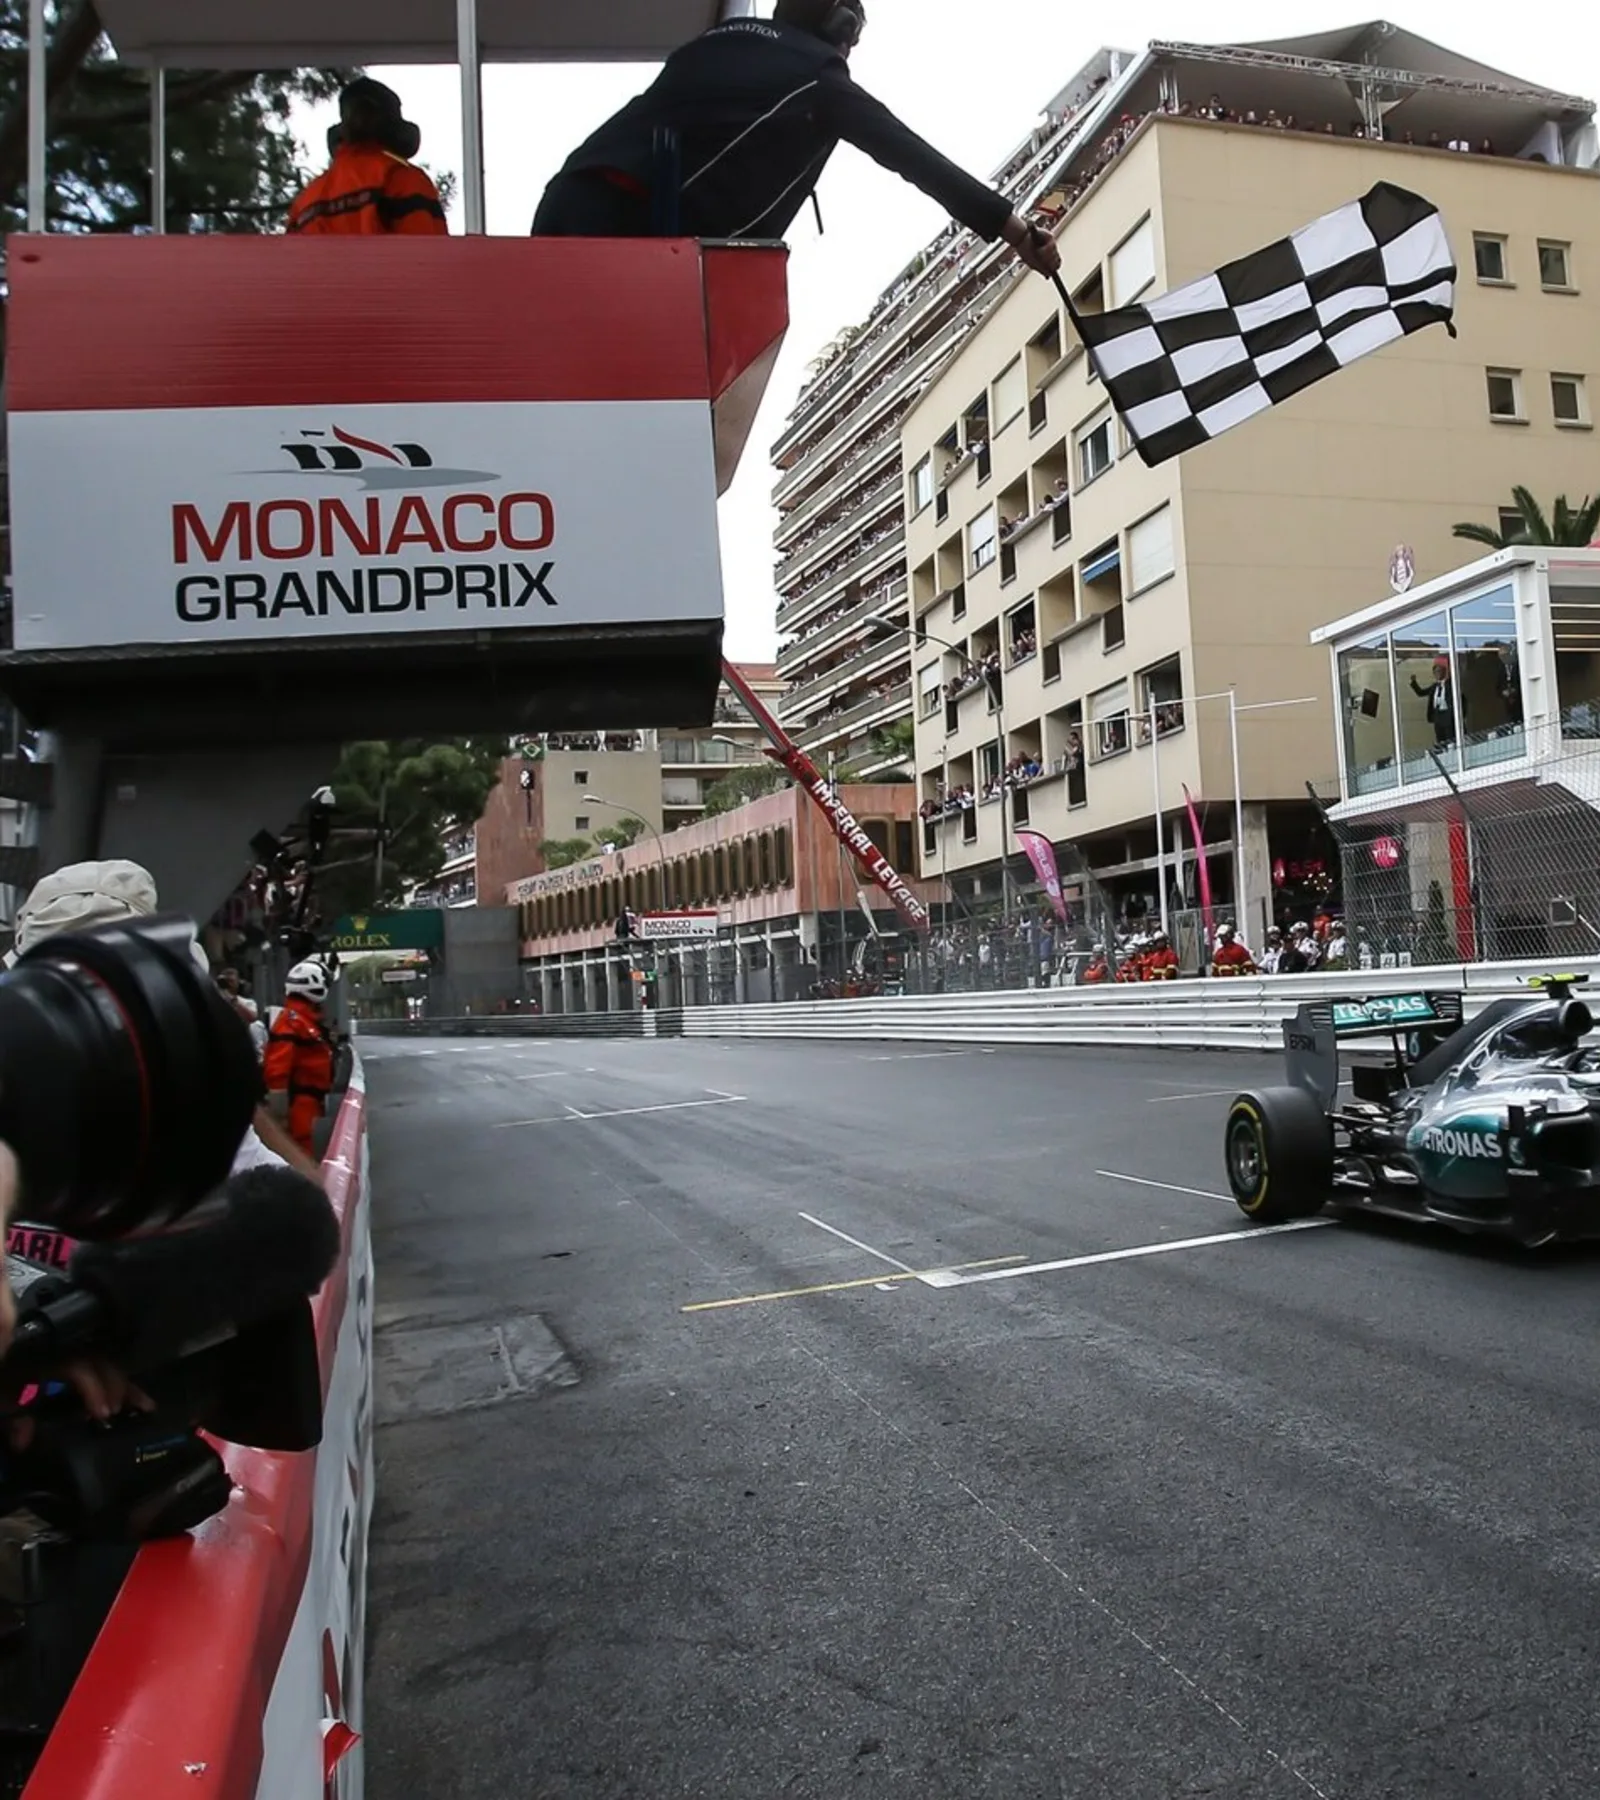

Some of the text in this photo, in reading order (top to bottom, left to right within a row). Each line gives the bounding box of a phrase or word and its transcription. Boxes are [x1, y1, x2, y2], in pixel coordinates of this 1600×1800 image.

[705, 23, 782, 39] ANISATION
[172, 492, 555, 564] MONACO
[175, 562, 558, 623] GRANDPRIX
[811, 778, 928, 922] IMPERIAL LEVAGE
[645, 919, 691, 929] MONACO
[645, 927, 691, 937] GRANDPRIX
